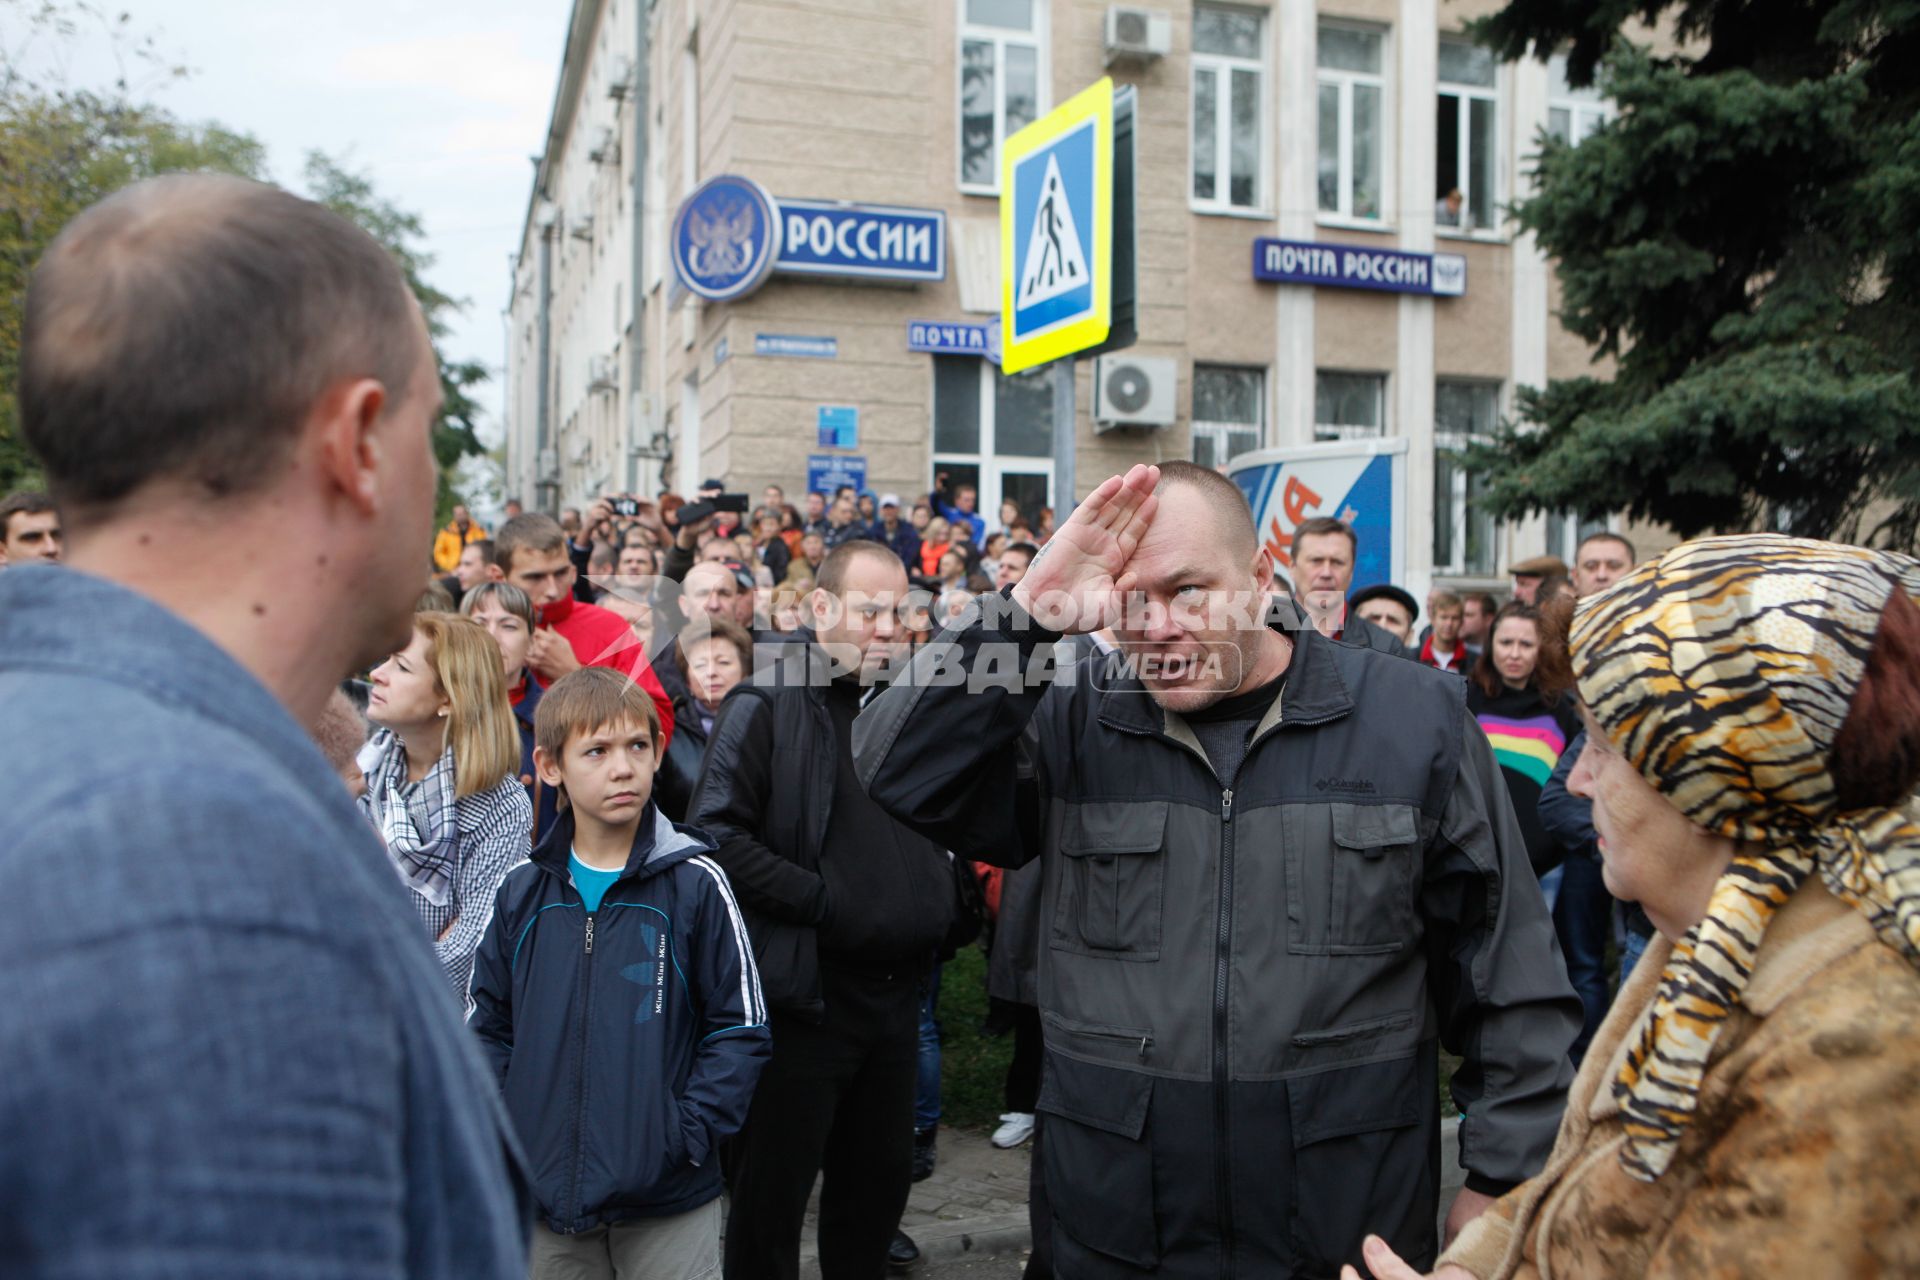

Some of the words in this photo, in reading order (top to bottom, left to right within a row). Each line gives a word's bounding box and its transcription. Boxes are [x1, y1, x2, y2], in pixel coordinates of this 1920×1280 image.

[787, 214, 930, 263] РОССИИ
[1265, 244, 1337, 277] ПОЧТА
[1343, 252, 1428, 285] РОССИИ
[911, 325, 984, 347] ПОЧТА
